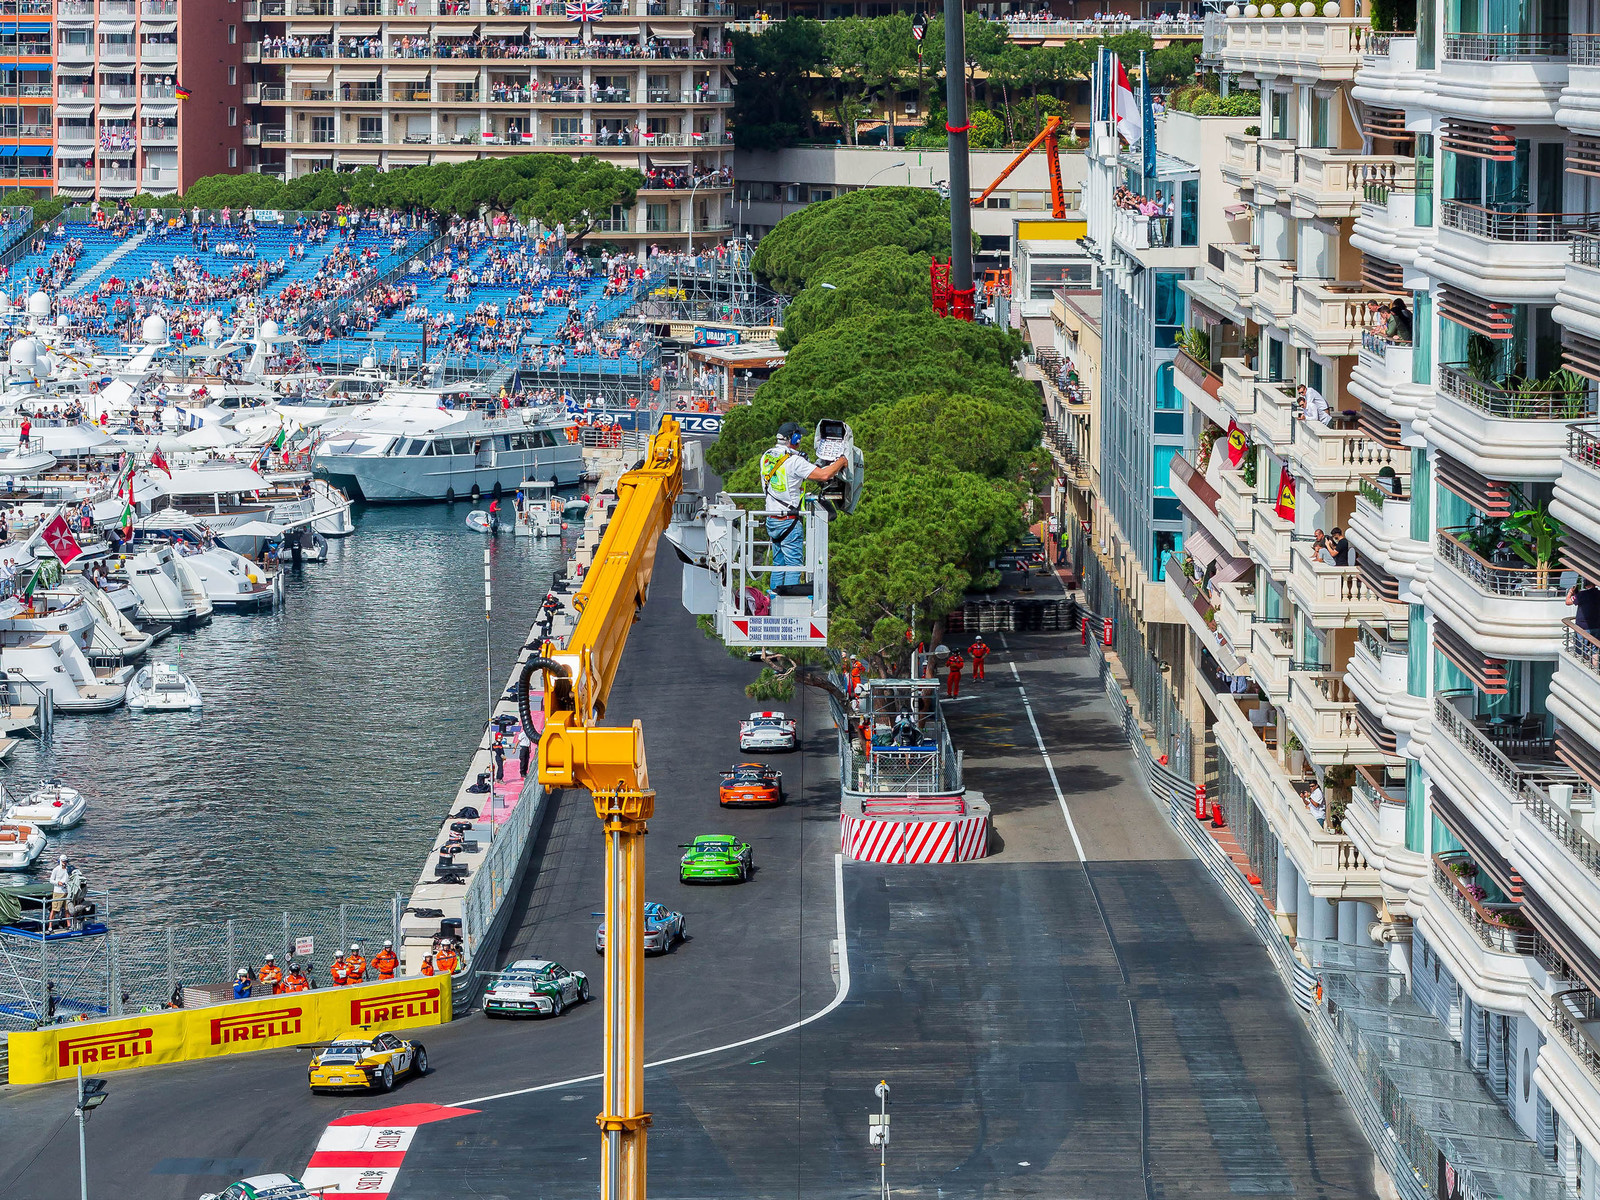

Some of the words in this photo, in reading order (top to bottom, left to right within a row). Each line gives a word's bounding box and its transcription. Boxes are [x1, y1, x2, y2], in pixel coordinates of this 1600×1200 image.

[706, 331, 726, 341] UBALDI
[350, 988, 440, 1025] PIRELLI
[210, 1007, 303, 1045] PIRELLI
[58, 1028, 154, 1067] PIRELLI
[375, 1135, 401, 1149] UBS
[356, 1176, 384, 1191] UBS
